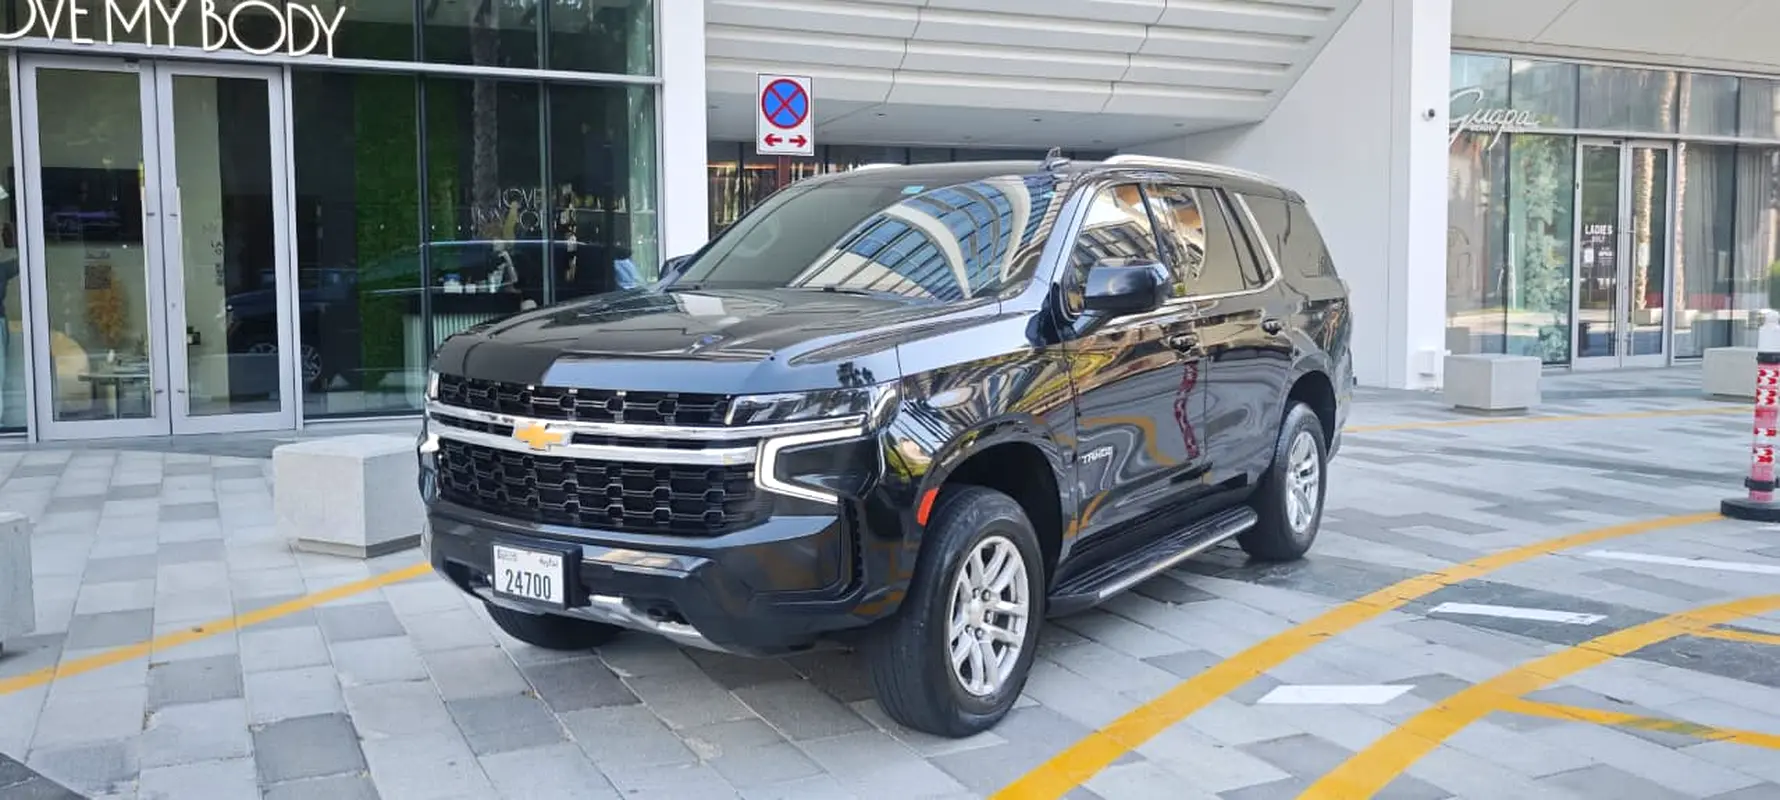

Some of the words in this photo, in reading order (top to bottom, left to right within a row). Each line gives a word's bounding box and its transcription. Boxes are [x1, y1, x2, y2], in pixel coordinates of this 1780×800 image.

[106, 0, 188, 49] MY
[201, 0, 346, 59] BODY
[1448, 87, 1541, 151] Guapa
[1585, 224, 1613, 235] LADIES
[1080, 446, 1113, 464] TAHOE
[505, 568, 552, 600] 24700
